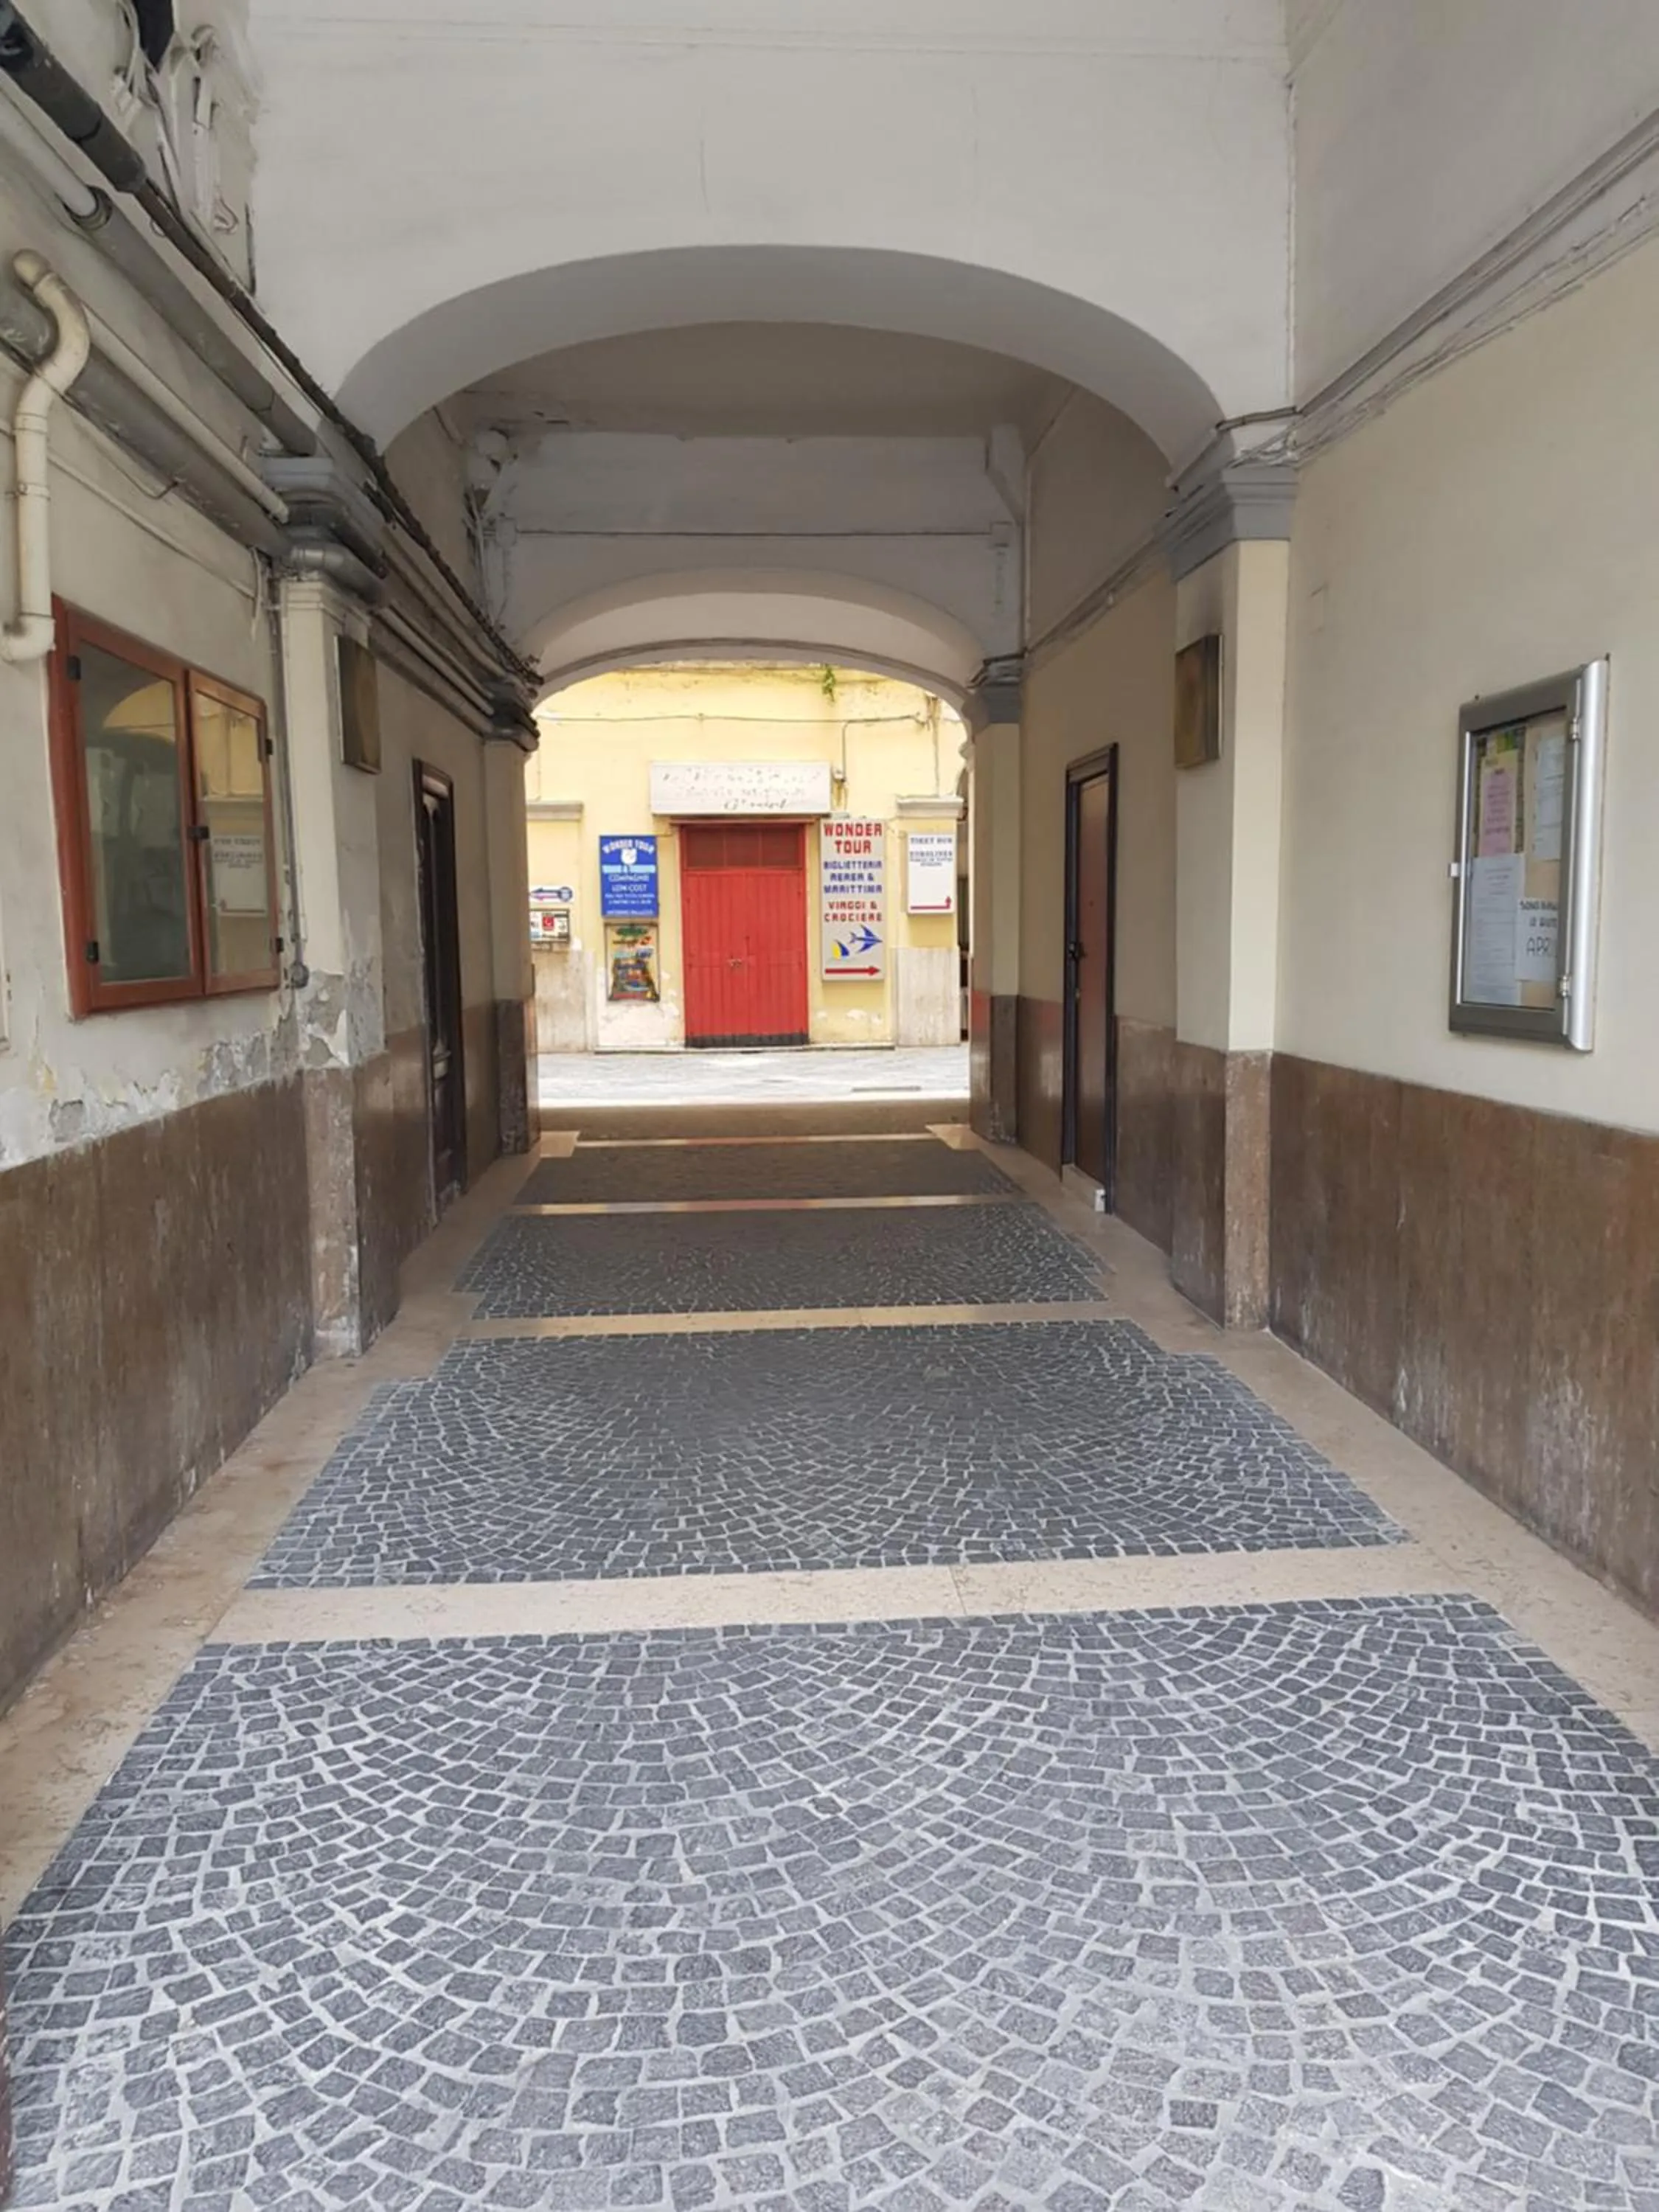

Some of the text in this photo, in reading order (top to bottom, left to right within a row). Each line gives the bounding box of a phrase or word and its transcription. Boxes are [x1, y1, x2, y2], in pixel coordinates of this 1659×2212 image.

[824, 823, 882, 836] WONDER
[835, 840, 872, 854] TOUR
[824, 860, 882, 869] BIGLIETTERIA
[830, 873, 864, 882] AEREA
[824, 885, 882, 894] MARITTIMA
[824, 913, 882, 922] CROCIERE
